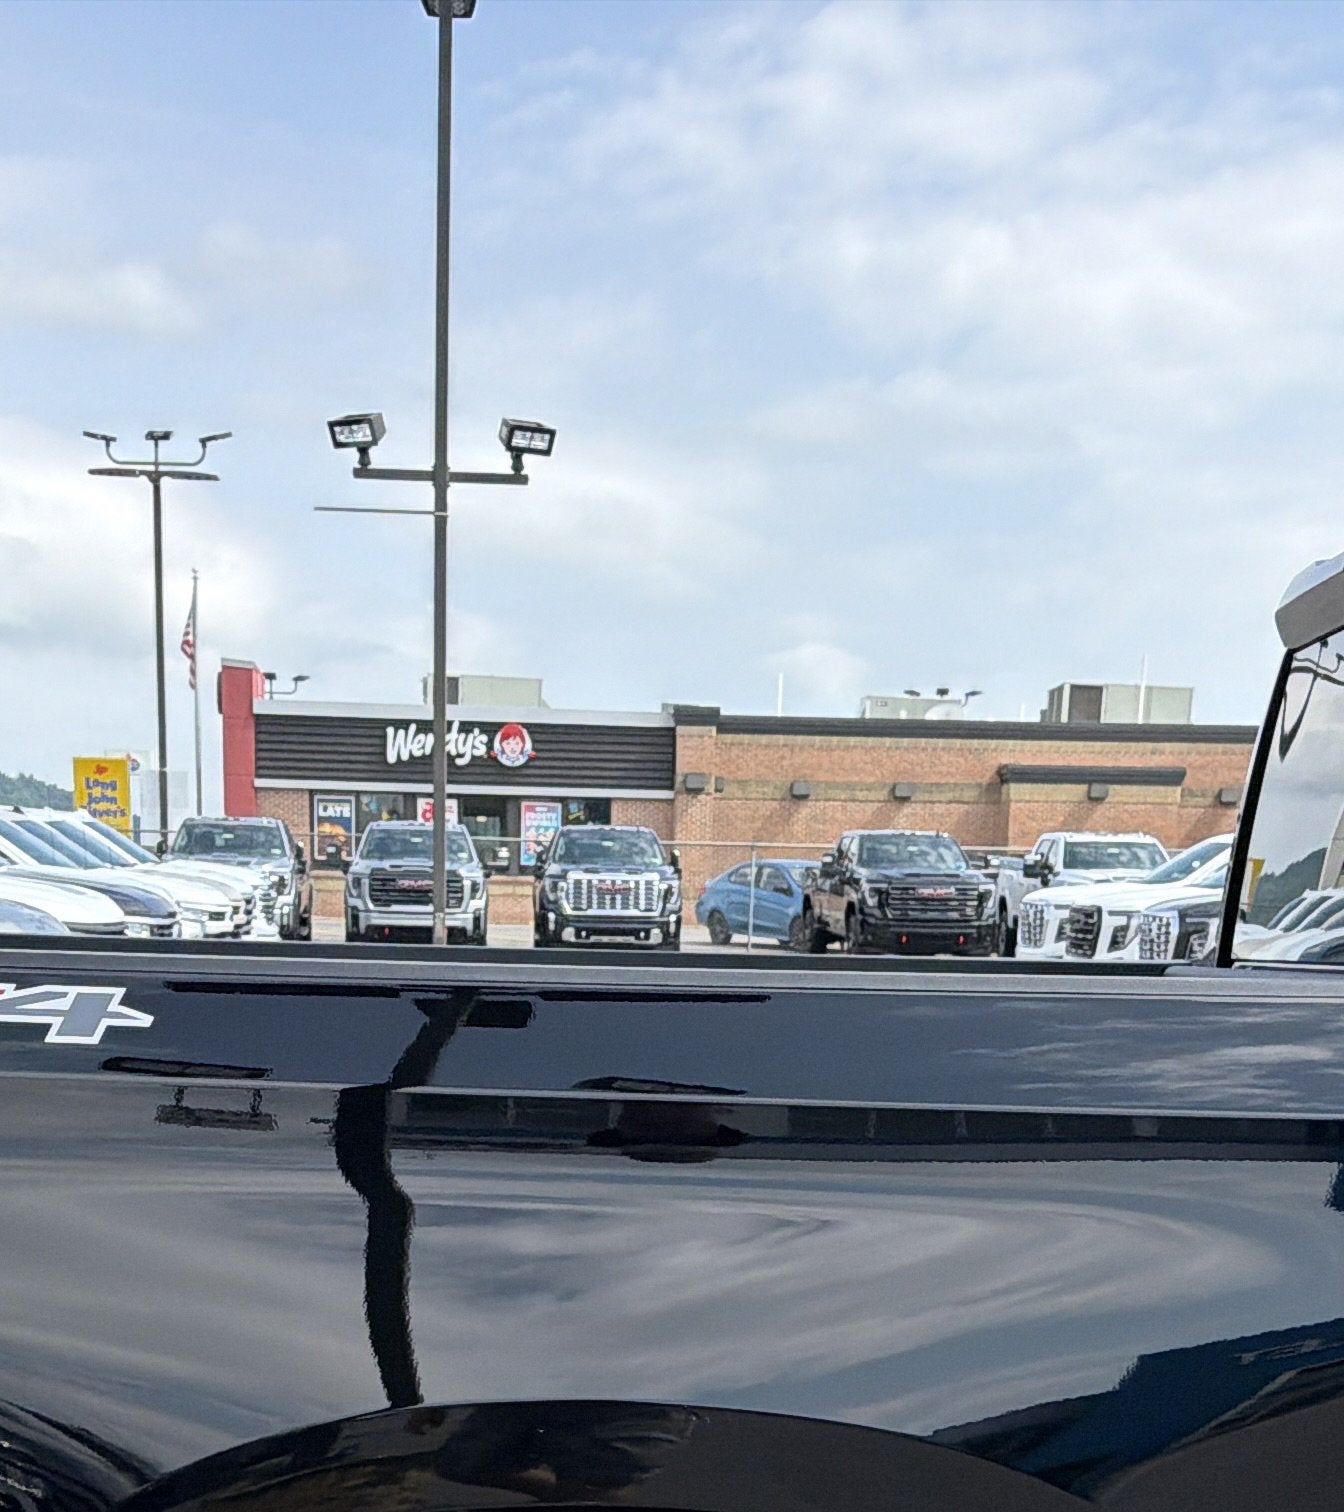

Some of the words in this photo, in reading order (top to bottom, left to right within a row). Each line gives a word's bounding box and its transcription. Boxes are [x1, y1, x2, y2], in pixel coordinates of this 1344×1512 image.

[84, 777, 118, 791] Long
[87, 792, 118, 806] John
[319, 803, 351, 818] LATE
